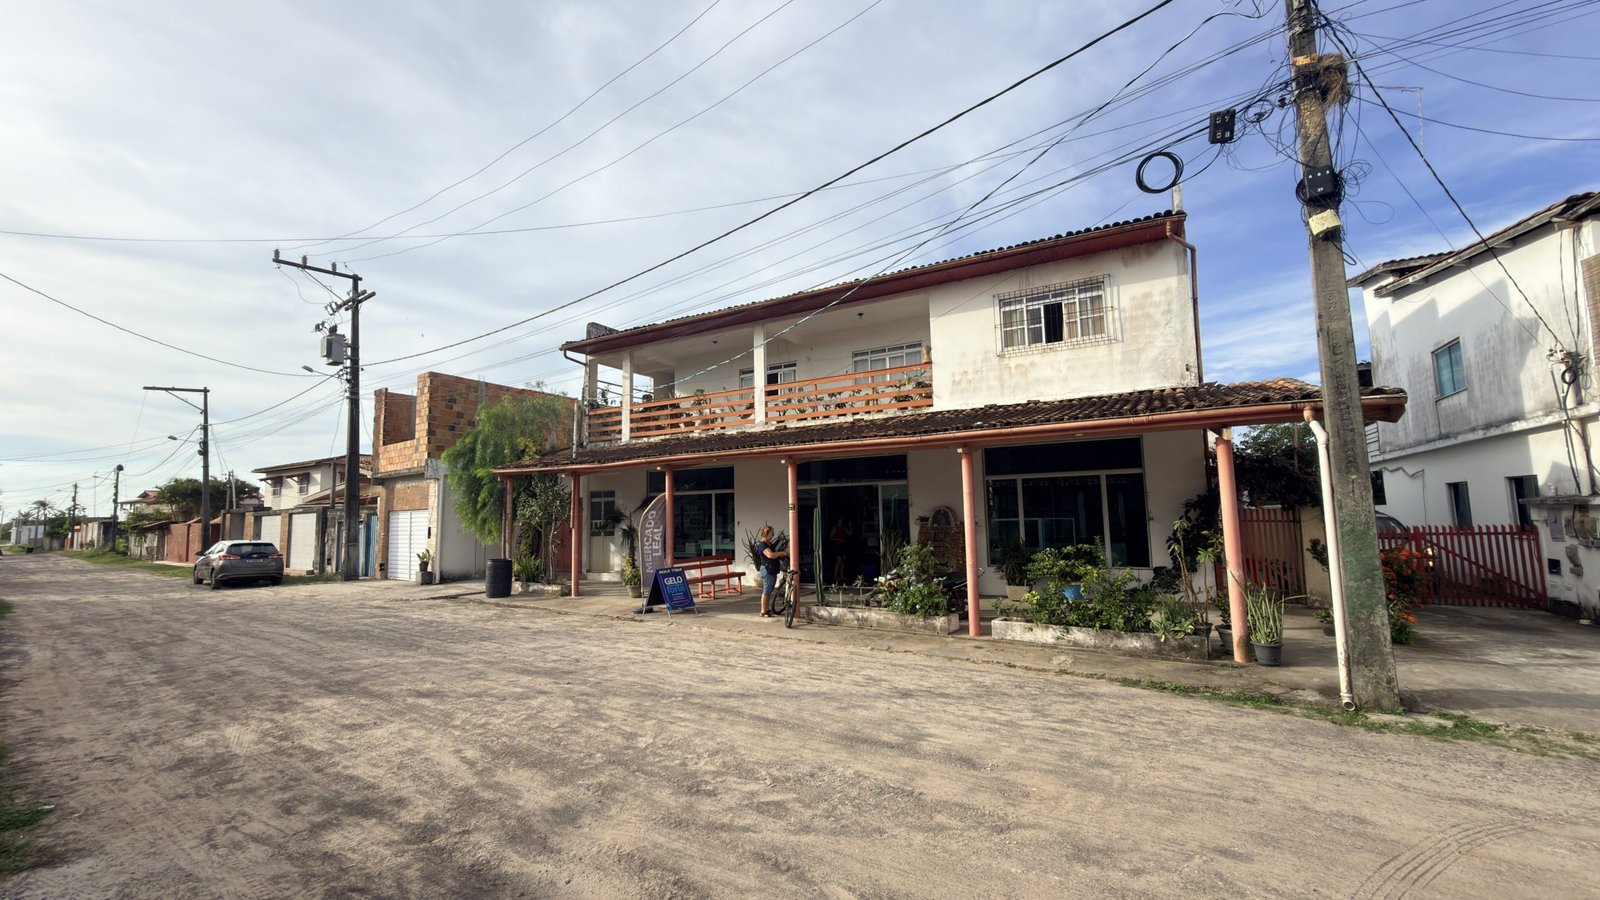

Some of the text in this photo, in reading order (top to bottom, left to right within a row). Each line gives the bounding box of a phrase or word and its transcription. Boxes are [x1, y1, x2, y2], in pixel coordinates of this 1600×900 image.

[644, 511, 656, 573] MERCADO
[652, 525, 663, 556] LEAL
[664, 576, 683, 585] GELO
